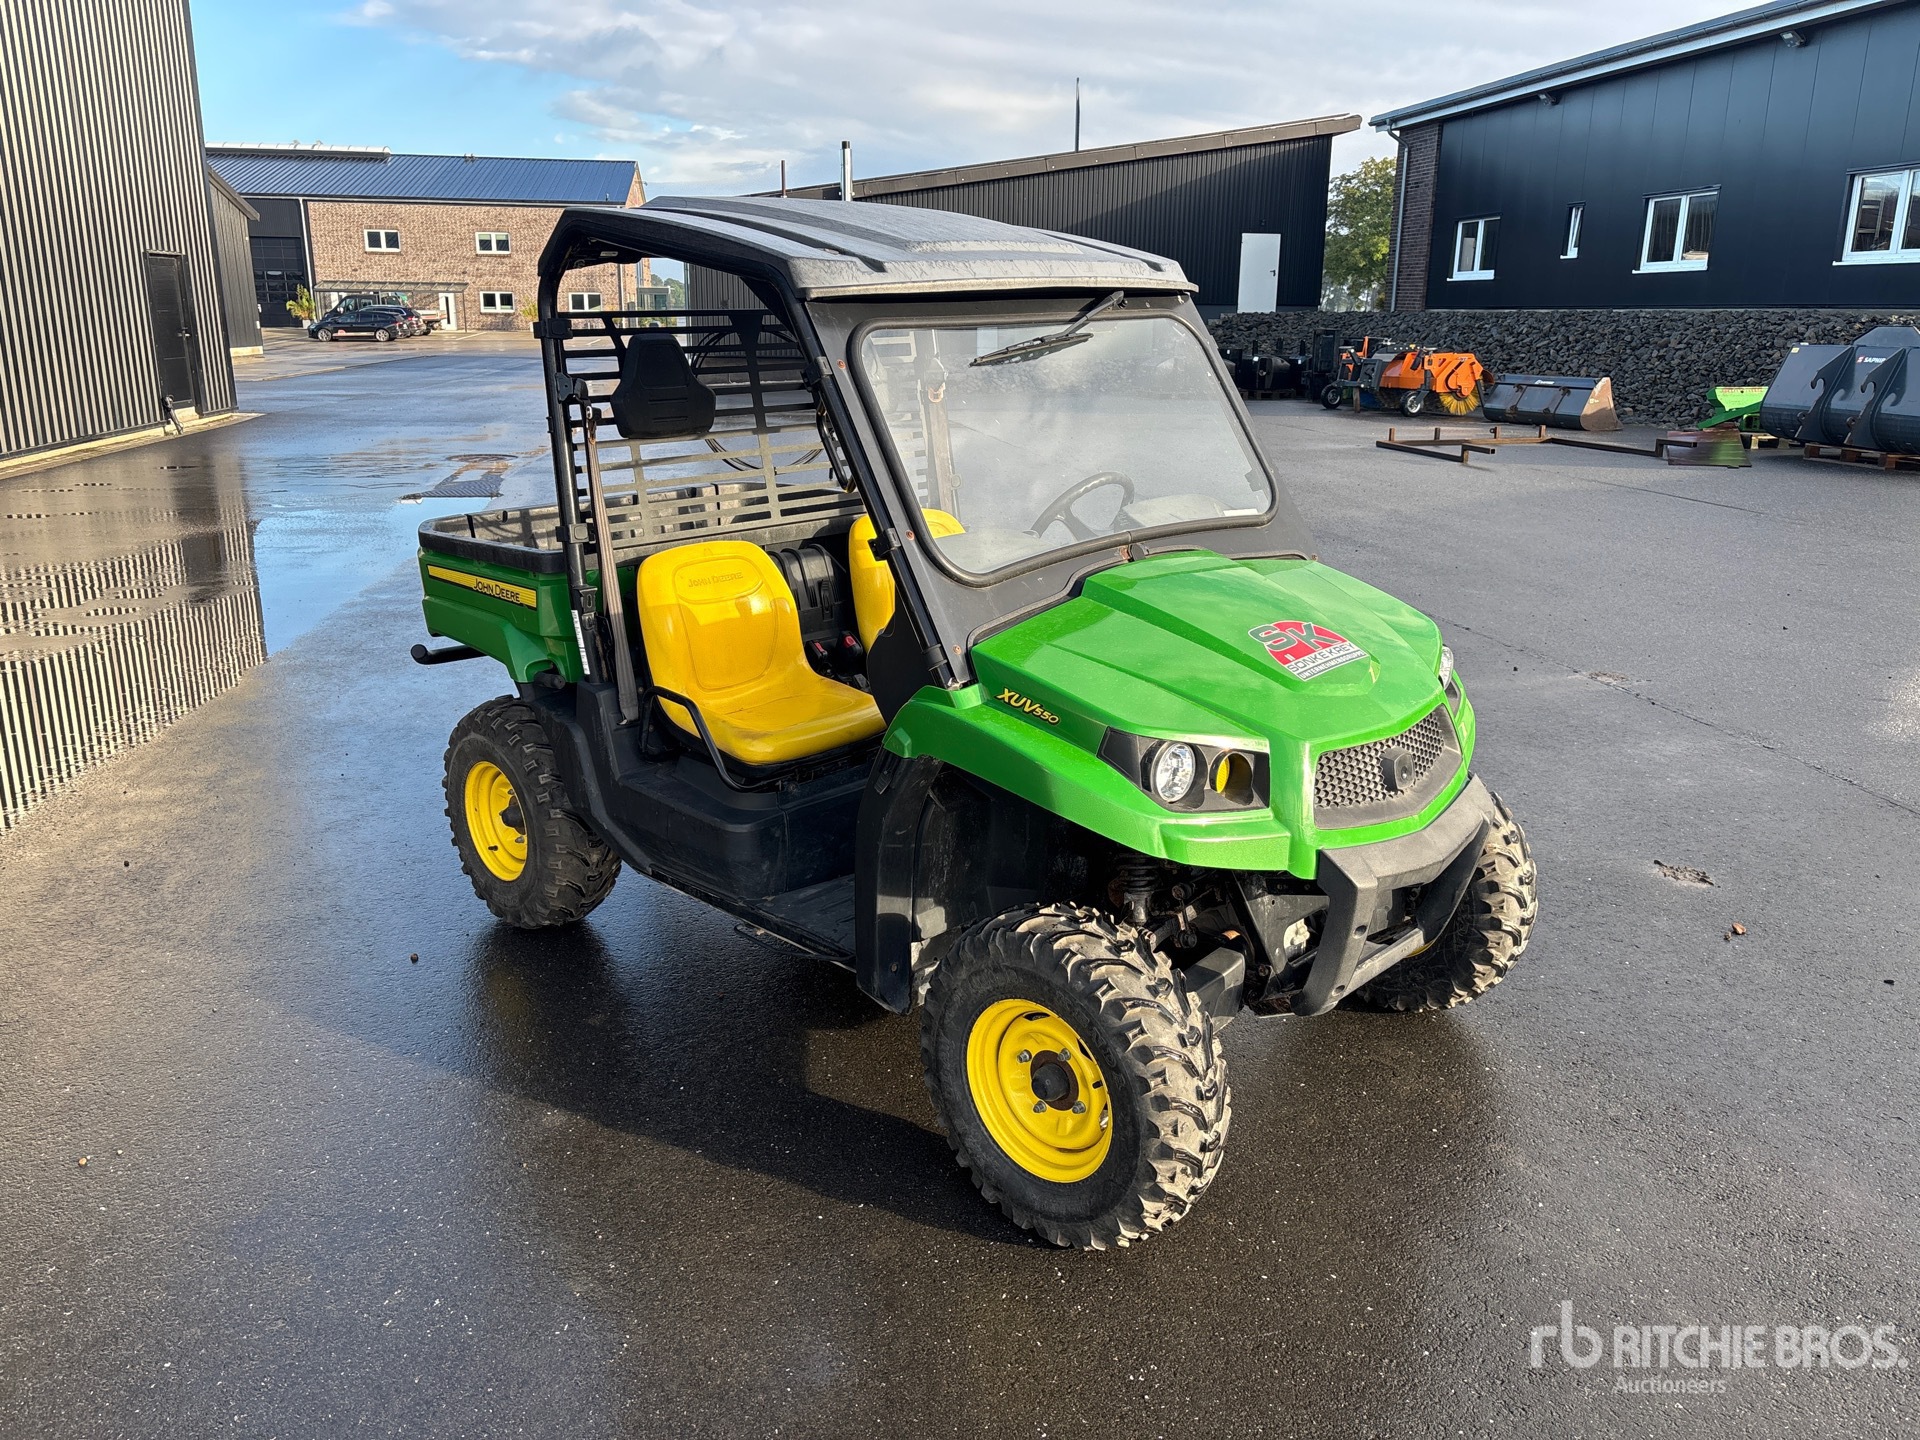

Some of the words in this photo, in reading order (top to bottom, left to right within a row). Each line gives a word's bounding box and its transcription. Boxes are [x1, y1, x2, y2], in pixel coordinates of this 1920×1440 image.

[688, 578, 711, 588] JOHN
[711, 572, 744, 585] DEERE
[473, 578, 494, 594] JOHN
[495, 584, 521, 603] DEERE
[1248, 622, 1342, 652] SK
[1325, 642, 1355, 656] KREY
